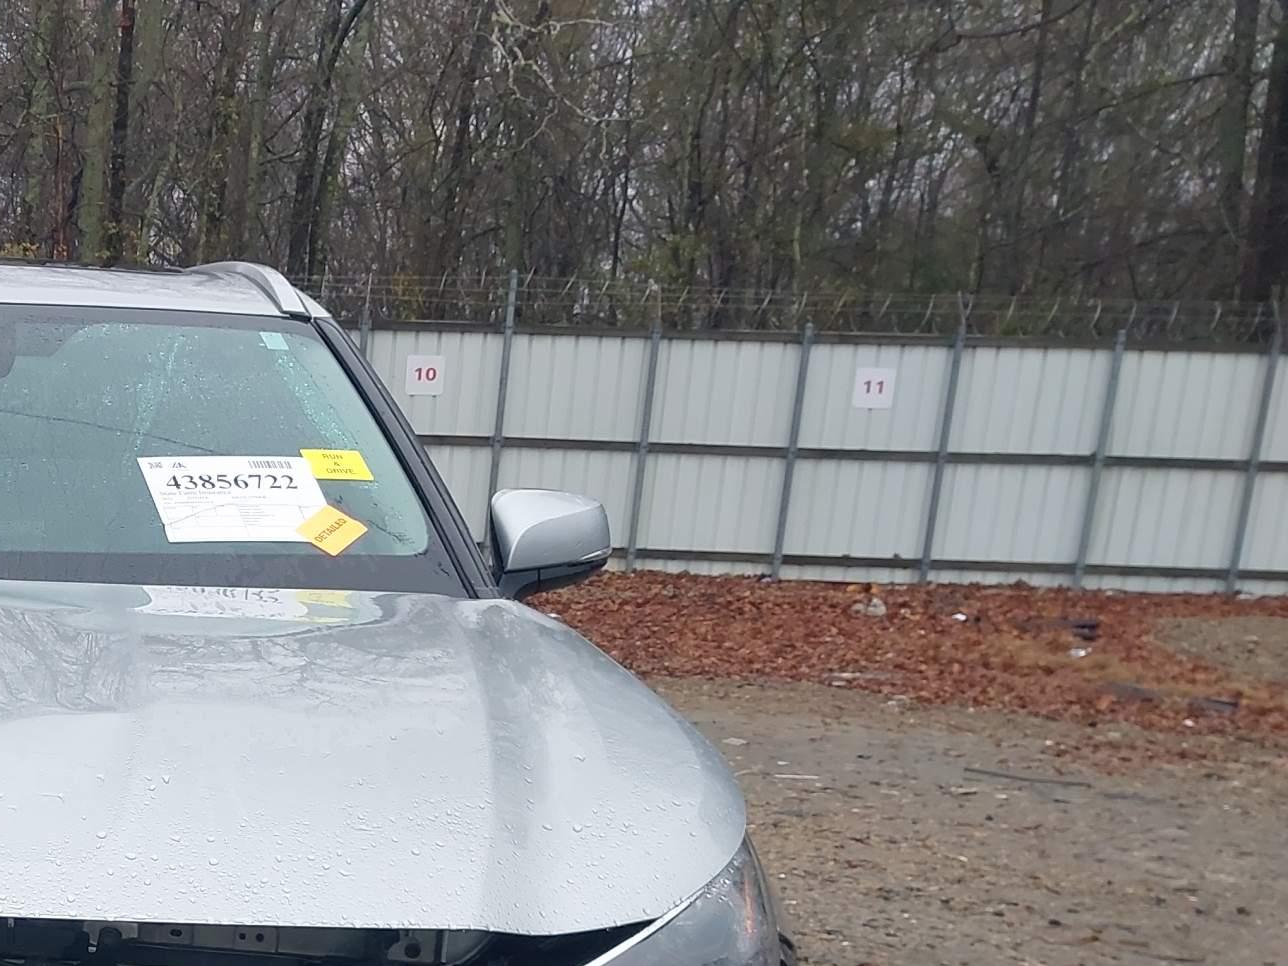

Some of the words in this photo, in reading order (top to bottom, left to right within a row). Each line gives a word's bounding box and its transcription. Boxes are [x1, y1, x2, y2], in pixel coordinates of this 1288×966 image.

[415, 367, 437, 381] 10
[863, 380, 884, 394] 11
[166, 474, 298, 490] 43856722
[314, 518, 347, 543] DETAILED
